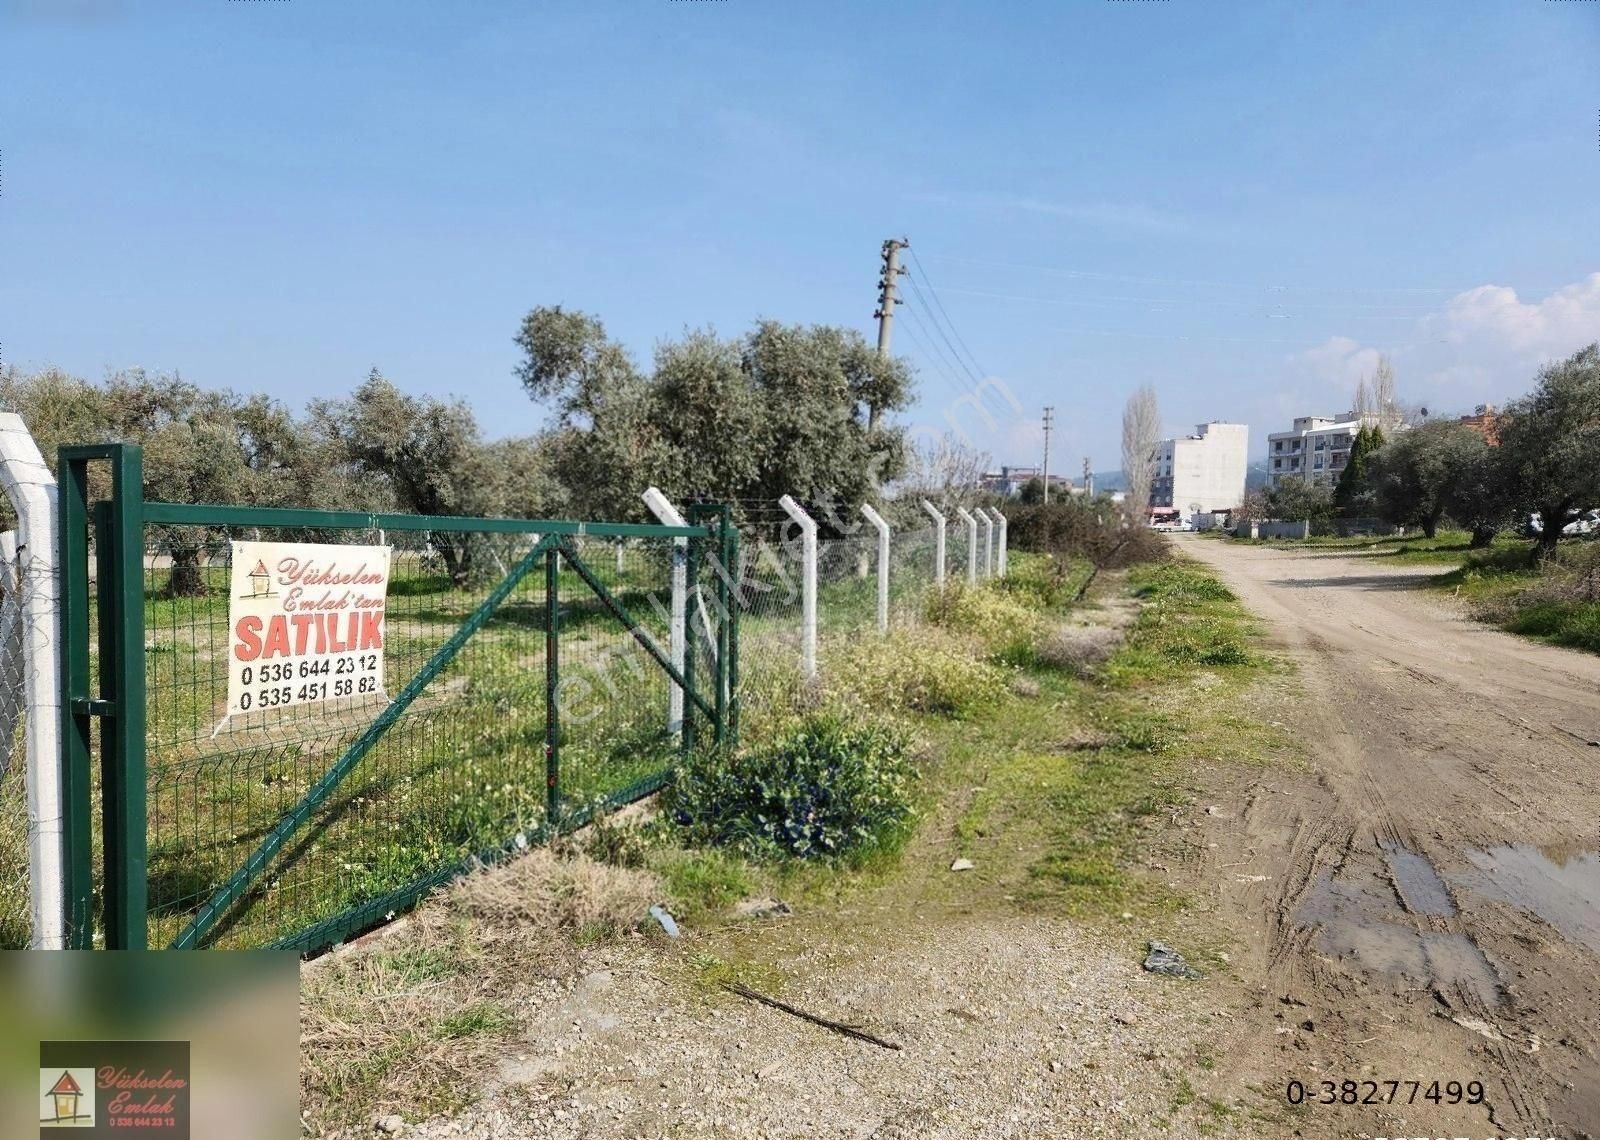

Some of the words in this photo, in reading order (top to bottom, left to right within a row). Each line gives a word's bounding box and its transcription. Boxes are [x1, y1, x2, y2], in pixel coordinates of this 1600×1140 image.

[277, 557, 384, 585] Yükselen
[283, 587, 385, 612] Emlak'tan
[234, 611, 385, 662] SATILIK
[241, 666, 253, 685] 0
[259, 662, 293, 683] 536
[299, 659, 330, 679] 644
[335, 657, 355, 674] 23
[358, 654, 377, 671] 12
[240, 692, 252, 710] 0
[258, 687, 292, 707] 535
[297, 683, 327, 702] 451
[334, 680, 353, 697] 58
[358, 676, 376, 693] 82
